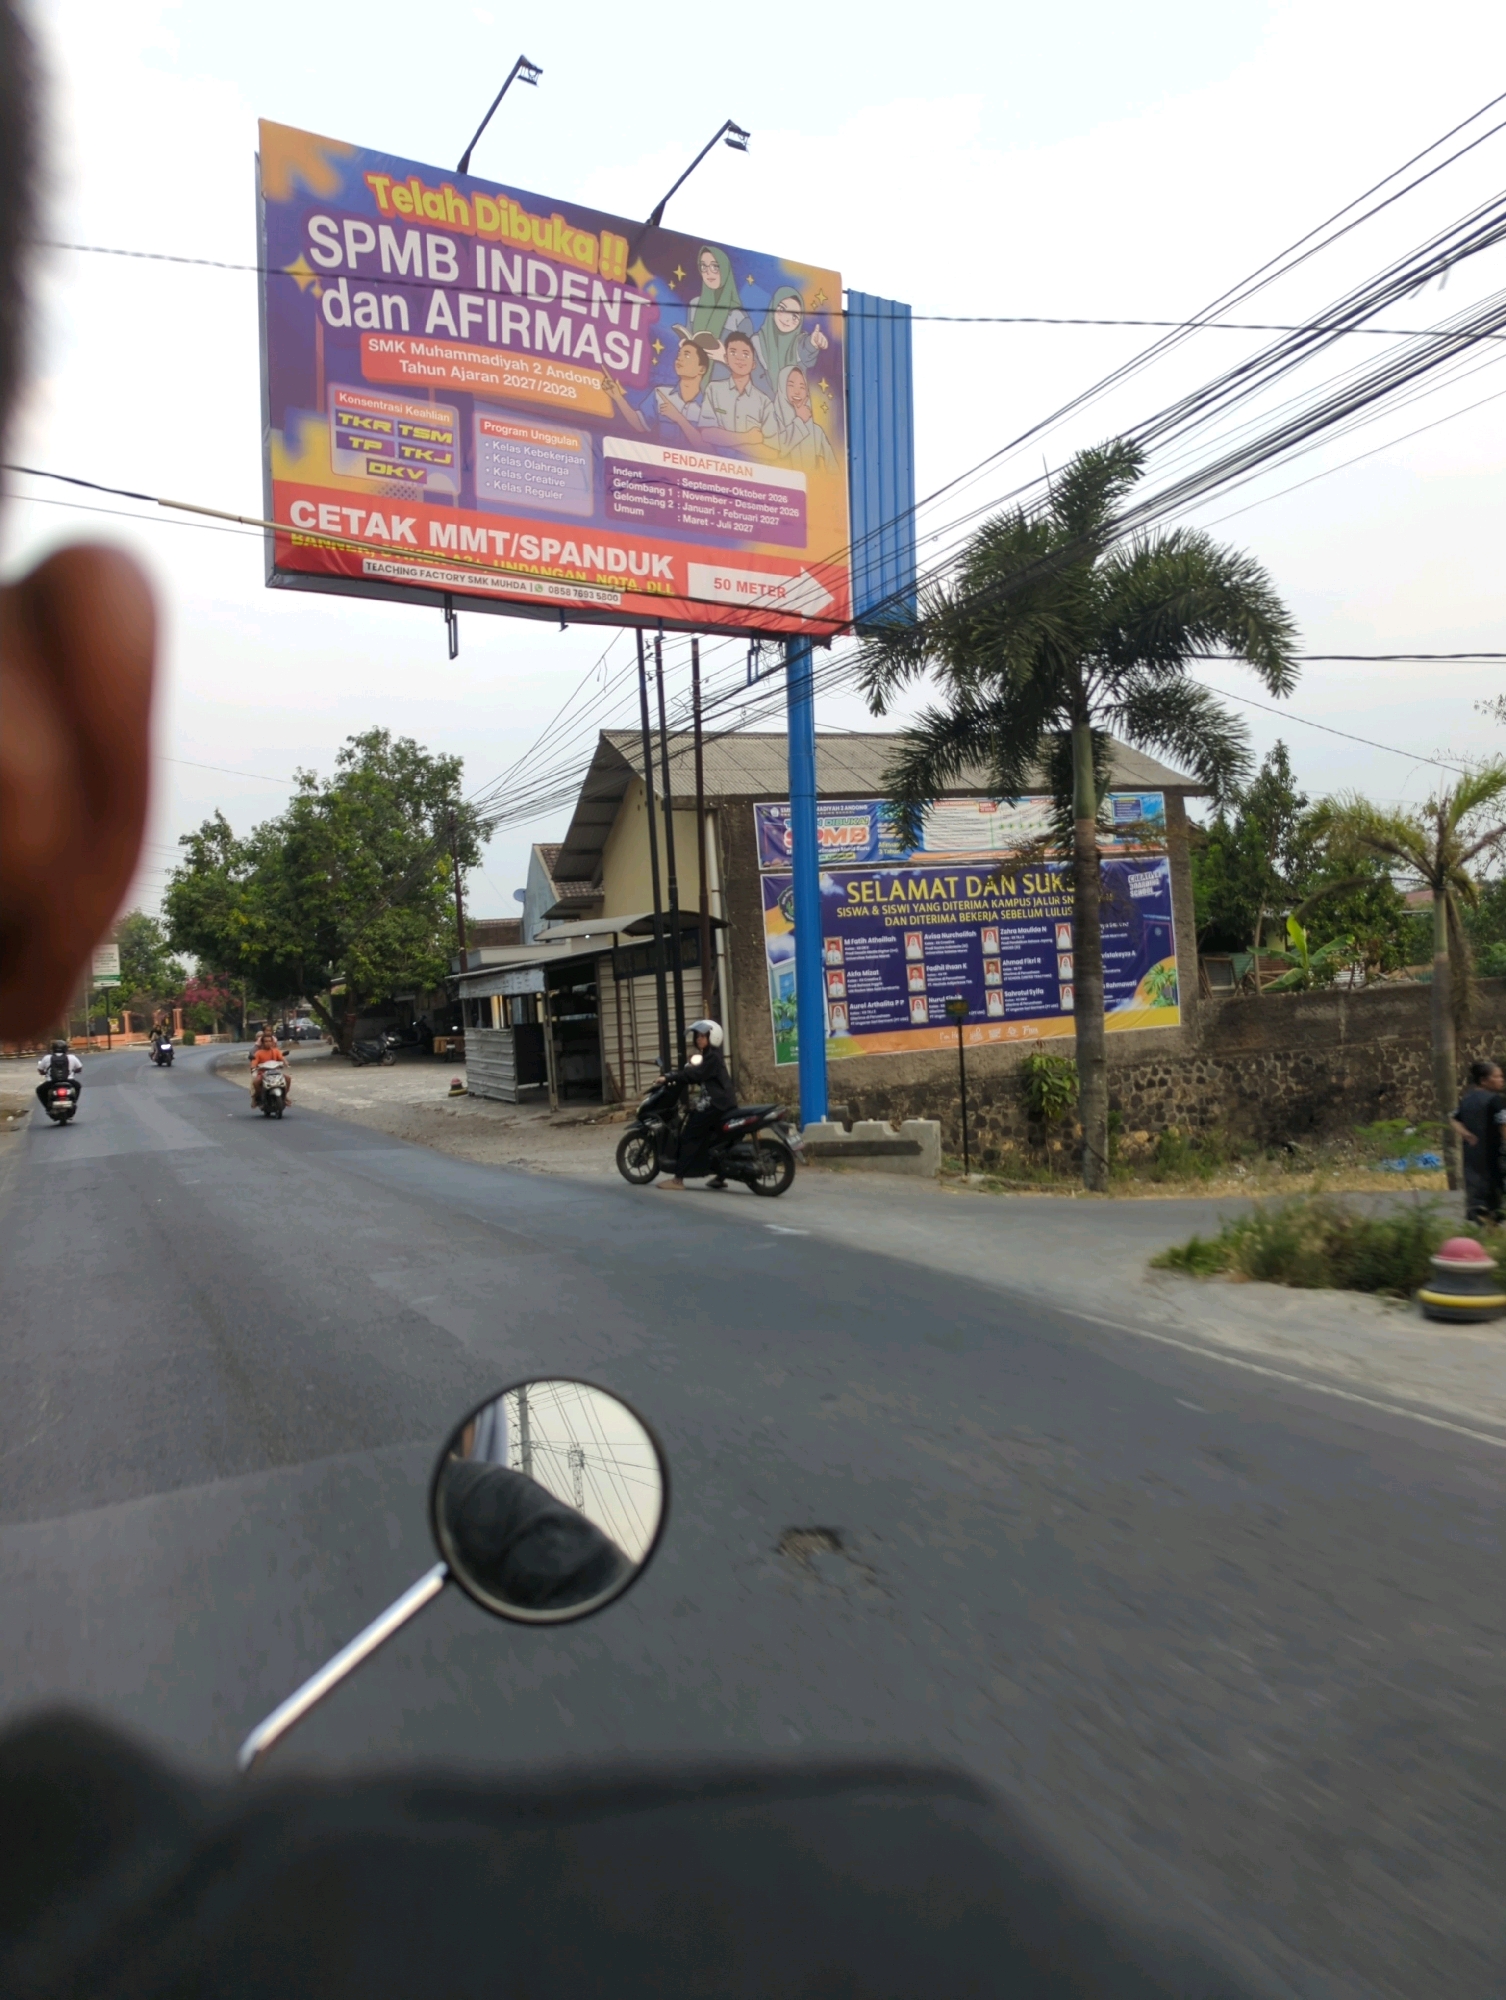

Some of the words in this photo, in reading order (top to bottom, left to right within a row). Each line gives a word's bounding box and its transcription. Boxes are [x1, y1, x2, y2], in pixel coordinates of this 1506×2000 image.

[367, 175, 469, 226] Telah
[475, 197, 597, 265] Dibuka
[599, 235, 625, 276] !!
[308, 214, 459, 282] SPMB
[476, 245, 652, 331] INDENT
[322, 276, 409, 331] dan
[425, 289, 643, 375] AFIRMASI
[368, 338, 406, 354] SMK
[410, 343, 529, 372] Muhammadiyah
[532, 363, 542, 375] 2
[546, 365, 601, 390] Andong
[399, 360, 446, 377] Tahun
[450, 364, 499, 384] Ajaran
[503, 374, 577, 399] 2027/2028
[339, 392, 402, 413] Konsentrasi
[405, 406, 450, 422] Keahlian
[338, 412, 392, 433] TKR
[399, 424, 453, 444] TSM
[484, 421, 528, 438] Program
[531, 430, 578, 447] Unggulan
[349, 436, 382, 451] TP
[401, 446, 452, 464] TKJ
[492, 441, 521, 454] Kelas
[524, 446, 586, 466] Kebekerjaan
[493, 454, 521, 467] Kelas
[524, 459, 569, 476] Olahraga
[663, 451, 753, 477] PENDAFTARAN
[368, 461, 425, 480] DKV
[493, 467, 522, 480] Kelas
[524, 473, 565, 488] Creative
[613, 466, 642, 478] Indent
[682, 478, 767, 500] September-Oktober
[493, 480, 522, 493] Kelas
[525, 485, 563, 500] Reguler
[613, 478, 665, 496] Gelombang
[682, 490, 727, 505] November
[735, 499, 778, 514] Desember
[613, 491, 666, 509] Gelombang
[668, 500, 674, 509] 2
[683, 503, 715, 515] Januari
[723, 509, 758, 522] Februari
[614, 503, 644, 516] Umum
[683, 514, 708, 526] Maret
[716, 520, 732, 530] Juli
[290, 500, 418, 544] CETAK
[429, 521, 674, 579] MMT/SPANDUK
[366, 561, 418, 576] TEACHING
[420, 569, 465, 582] FACTORY
[468, 576, 488, 586] SMK
[491, 578, 527, 590] MUHDA
[548, 586, 571, 597] 0858
[714, 578, 731, 591] 50
[736, 581, 787, 598] METER
[846, 876, 959, 904] SELAMAT
[965, 874, 1016, 898] DAN
[837, 906, 869, 917] SISWA
[872, 905, 879, 915] &
[882, 904, 910, 915] SISWI
[913, 902, 940, 913] YANG
[943, 899, 989, 911] DITERIMA
[991, 898, 1030, 909] KAMPUS
[1033, 896, 1060, 908] JALUR
[885, 916, 907, 926] DAN
[910, 913, 956, 925] DITERIMA
[959, 911, 998, 922] BEKERJA
[1001, 909, 1042, 919] SEBELUM
[1045, 907, 1073, 917] LULUS
